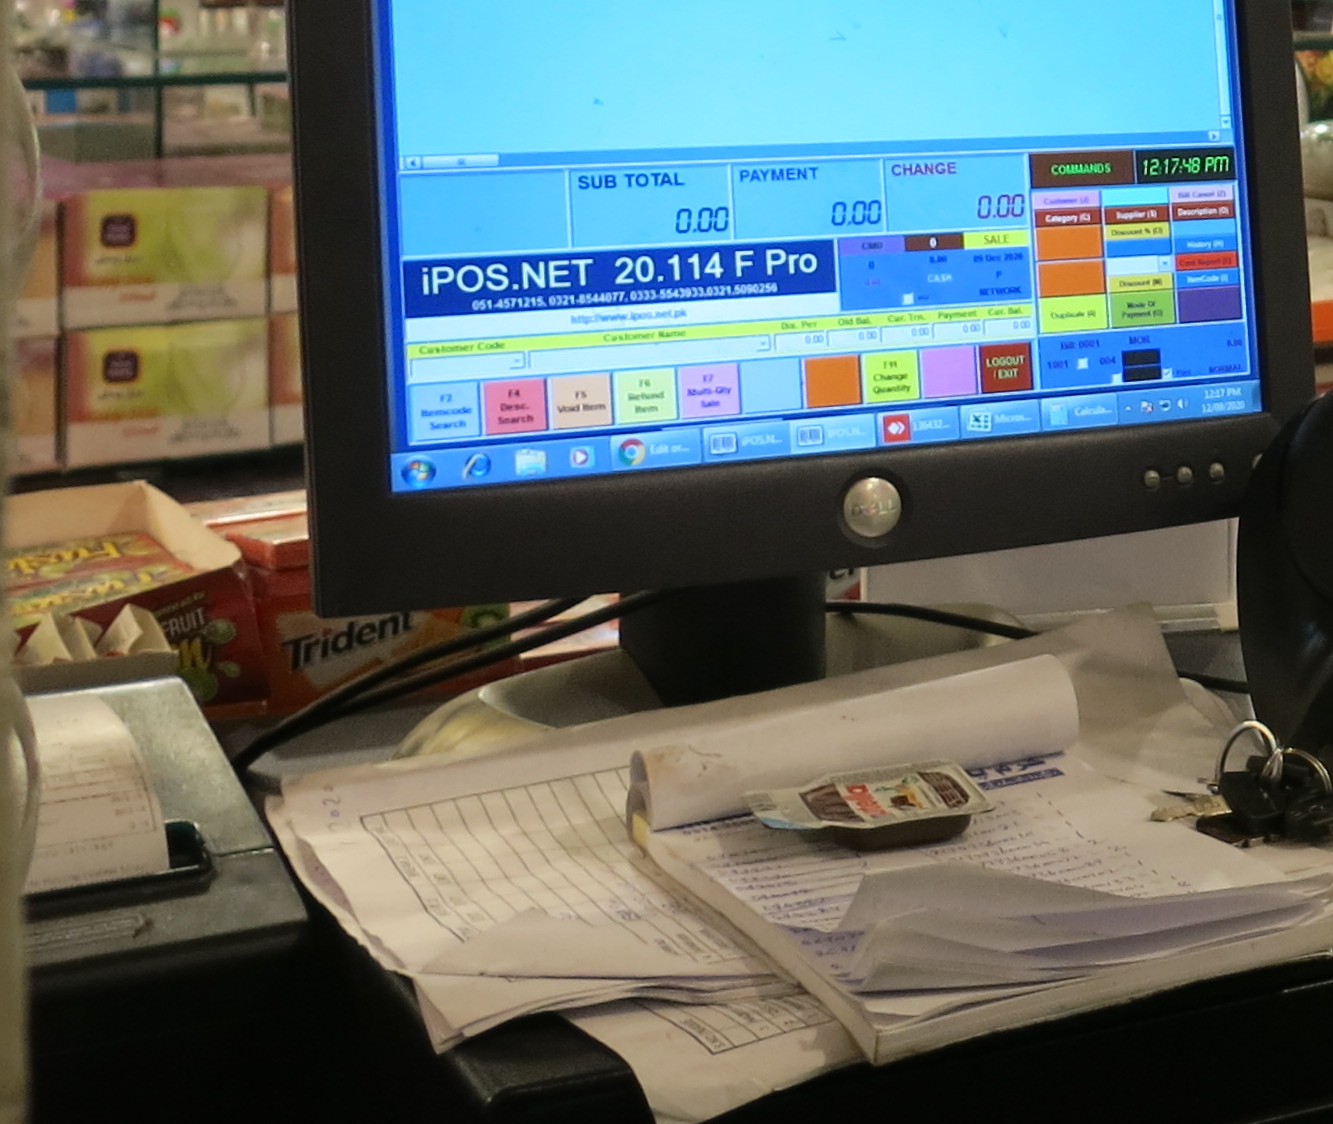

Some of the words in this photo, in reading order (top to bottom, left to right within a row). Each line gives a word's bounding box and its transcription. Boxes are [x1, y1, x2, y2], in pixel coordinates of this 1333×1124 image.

[739, 166, 819, 183] PAYMENT
[890, 161, 958, 177] CHANGE
[1050, 162, 1112, 176] COMMANDS
[1141, 157, 1202, 176] 12:17:48
[1203, 155, 1230, 173] PM
[578, 173, 617, 190] SUB
[624, 171, 686, 189] TOTAL
[831, 199, 883, 227] 0.00
[976, 193, 1026, 220] 0.00
[675, 206, 729, 235] 0.00
[983, 233, 1010, 245] SALE
[421, 258, 594, 296] iPOS.NET
[614, 252, 724, 285] 20.114
[735, 249, 755, 278] F
[765, 247, 818, 276] Pro
[602, 329, 656, 343] Customer
[418, 341, 475, 355] Customer
[477, 339, 506, 352] Code
[985, 354, 1027, 369] LOGOUT
[280, 611, 413, 671] Trident
